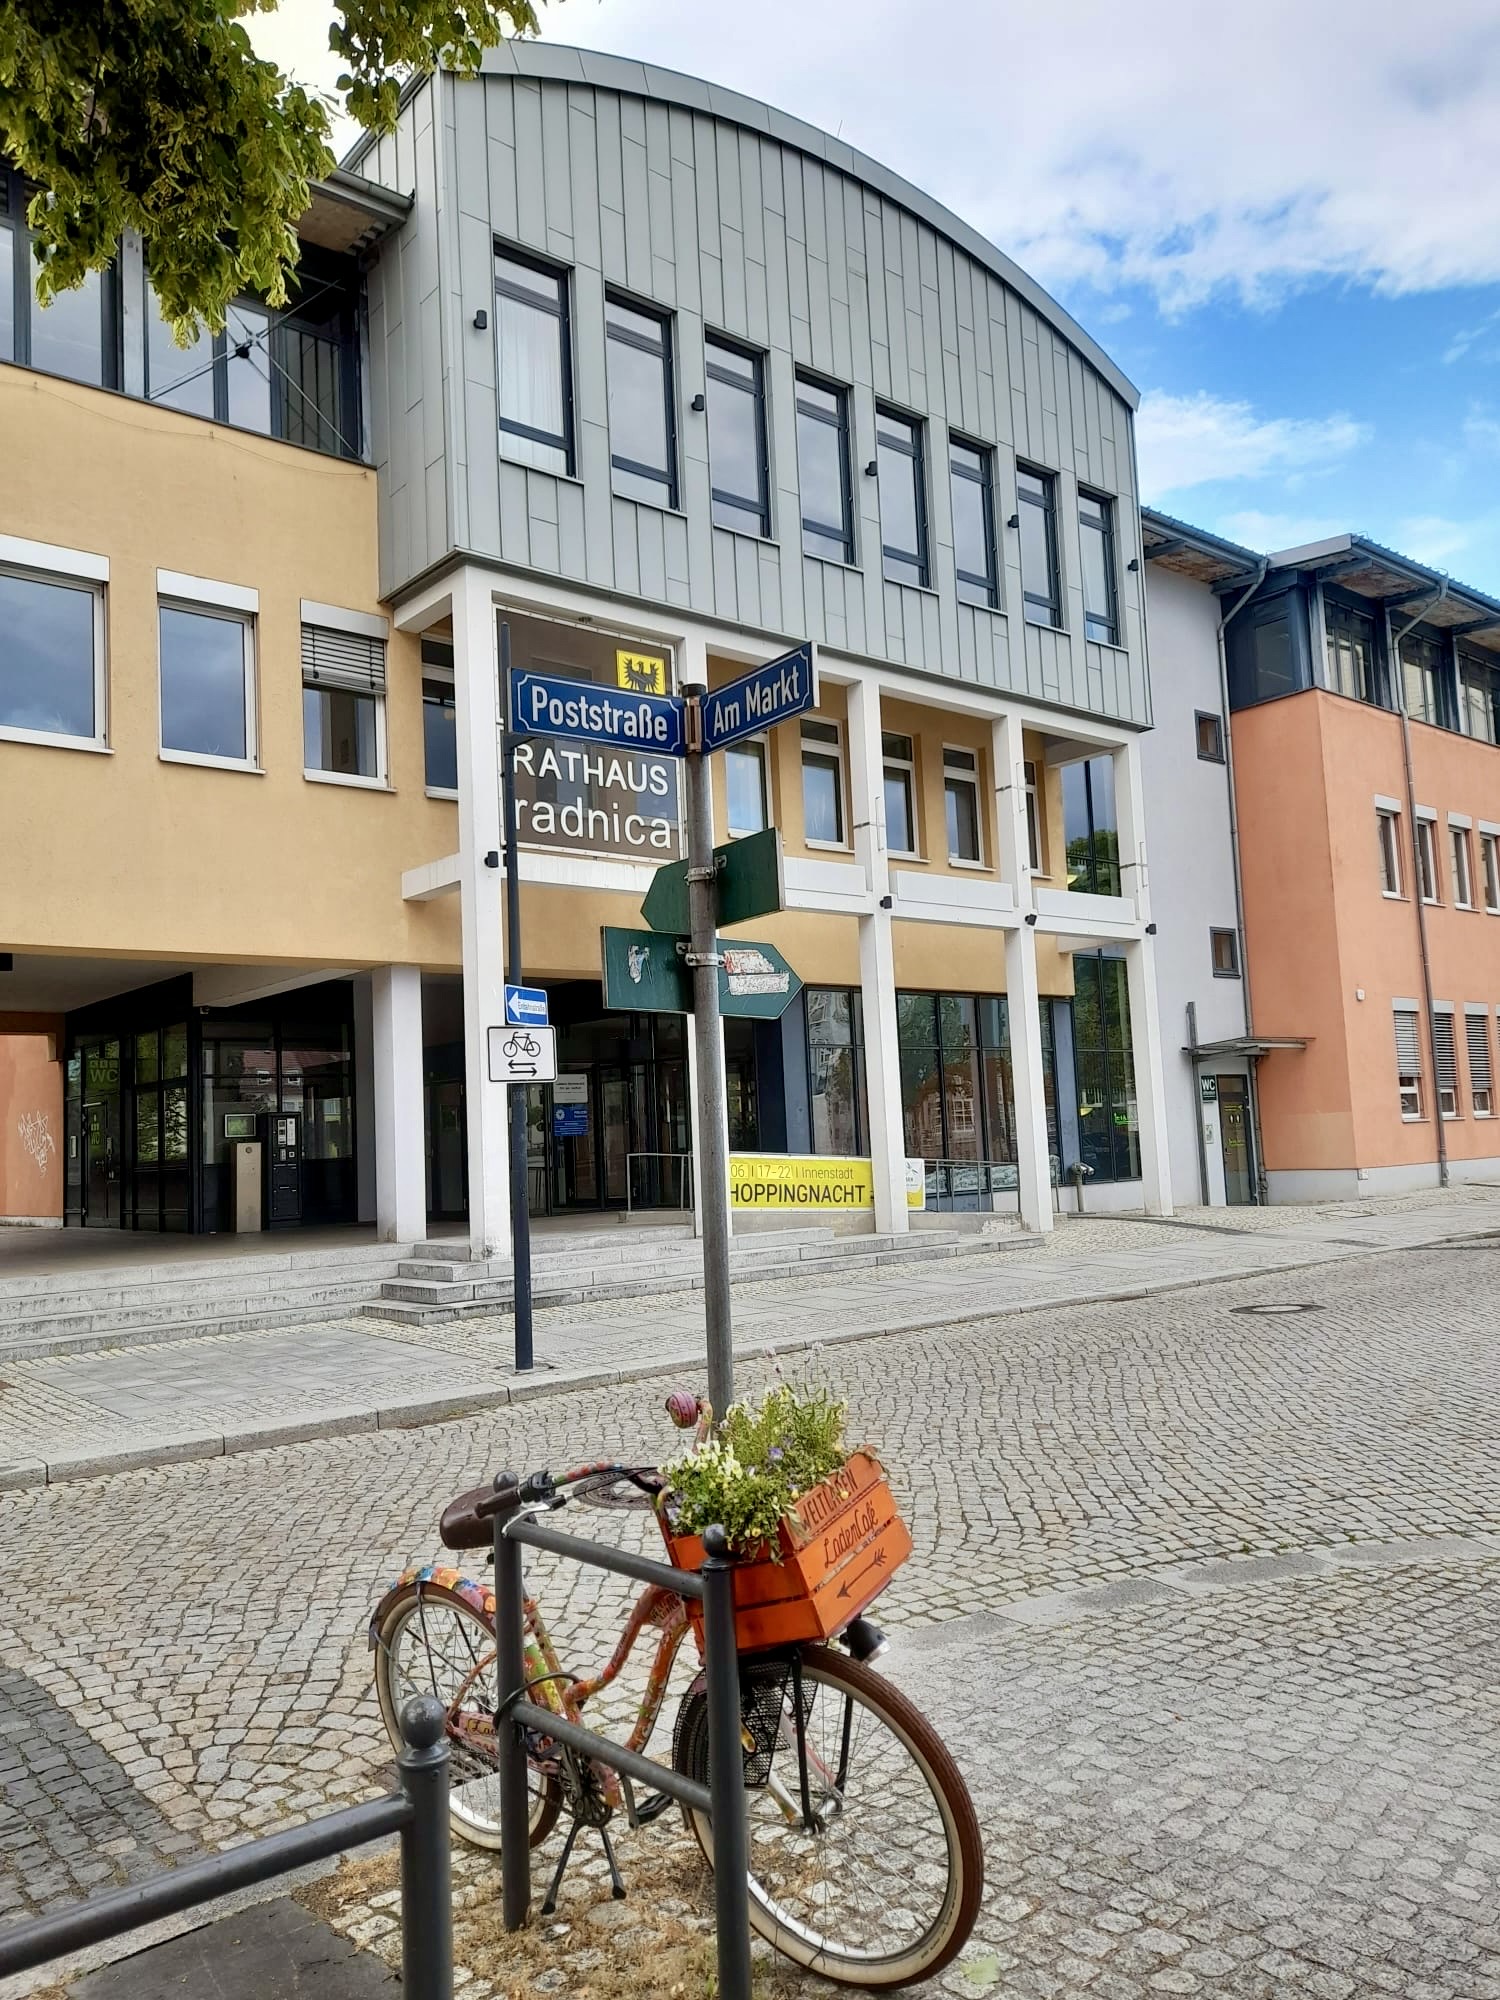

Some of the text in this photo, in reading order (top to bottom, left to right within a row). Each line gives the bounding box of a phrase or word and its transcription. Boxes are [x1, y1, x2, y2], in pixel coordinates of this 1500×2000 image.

[531, 685, 668, 741] Poststraße
[713, 664, 800, 737] Am Markt
[513, 743, 669, 796] RATHAUS
[515, 797, 672, 849] radnica
[90, 1069, 119, 1083] WC
[1201, 1078, 1216, 1090] WC
[758, 1164, 791, 1179] 17-22
[802, 1166, 855, 1180] Innenstadt
[824, 1500, 879, 1568] LadenCafé
